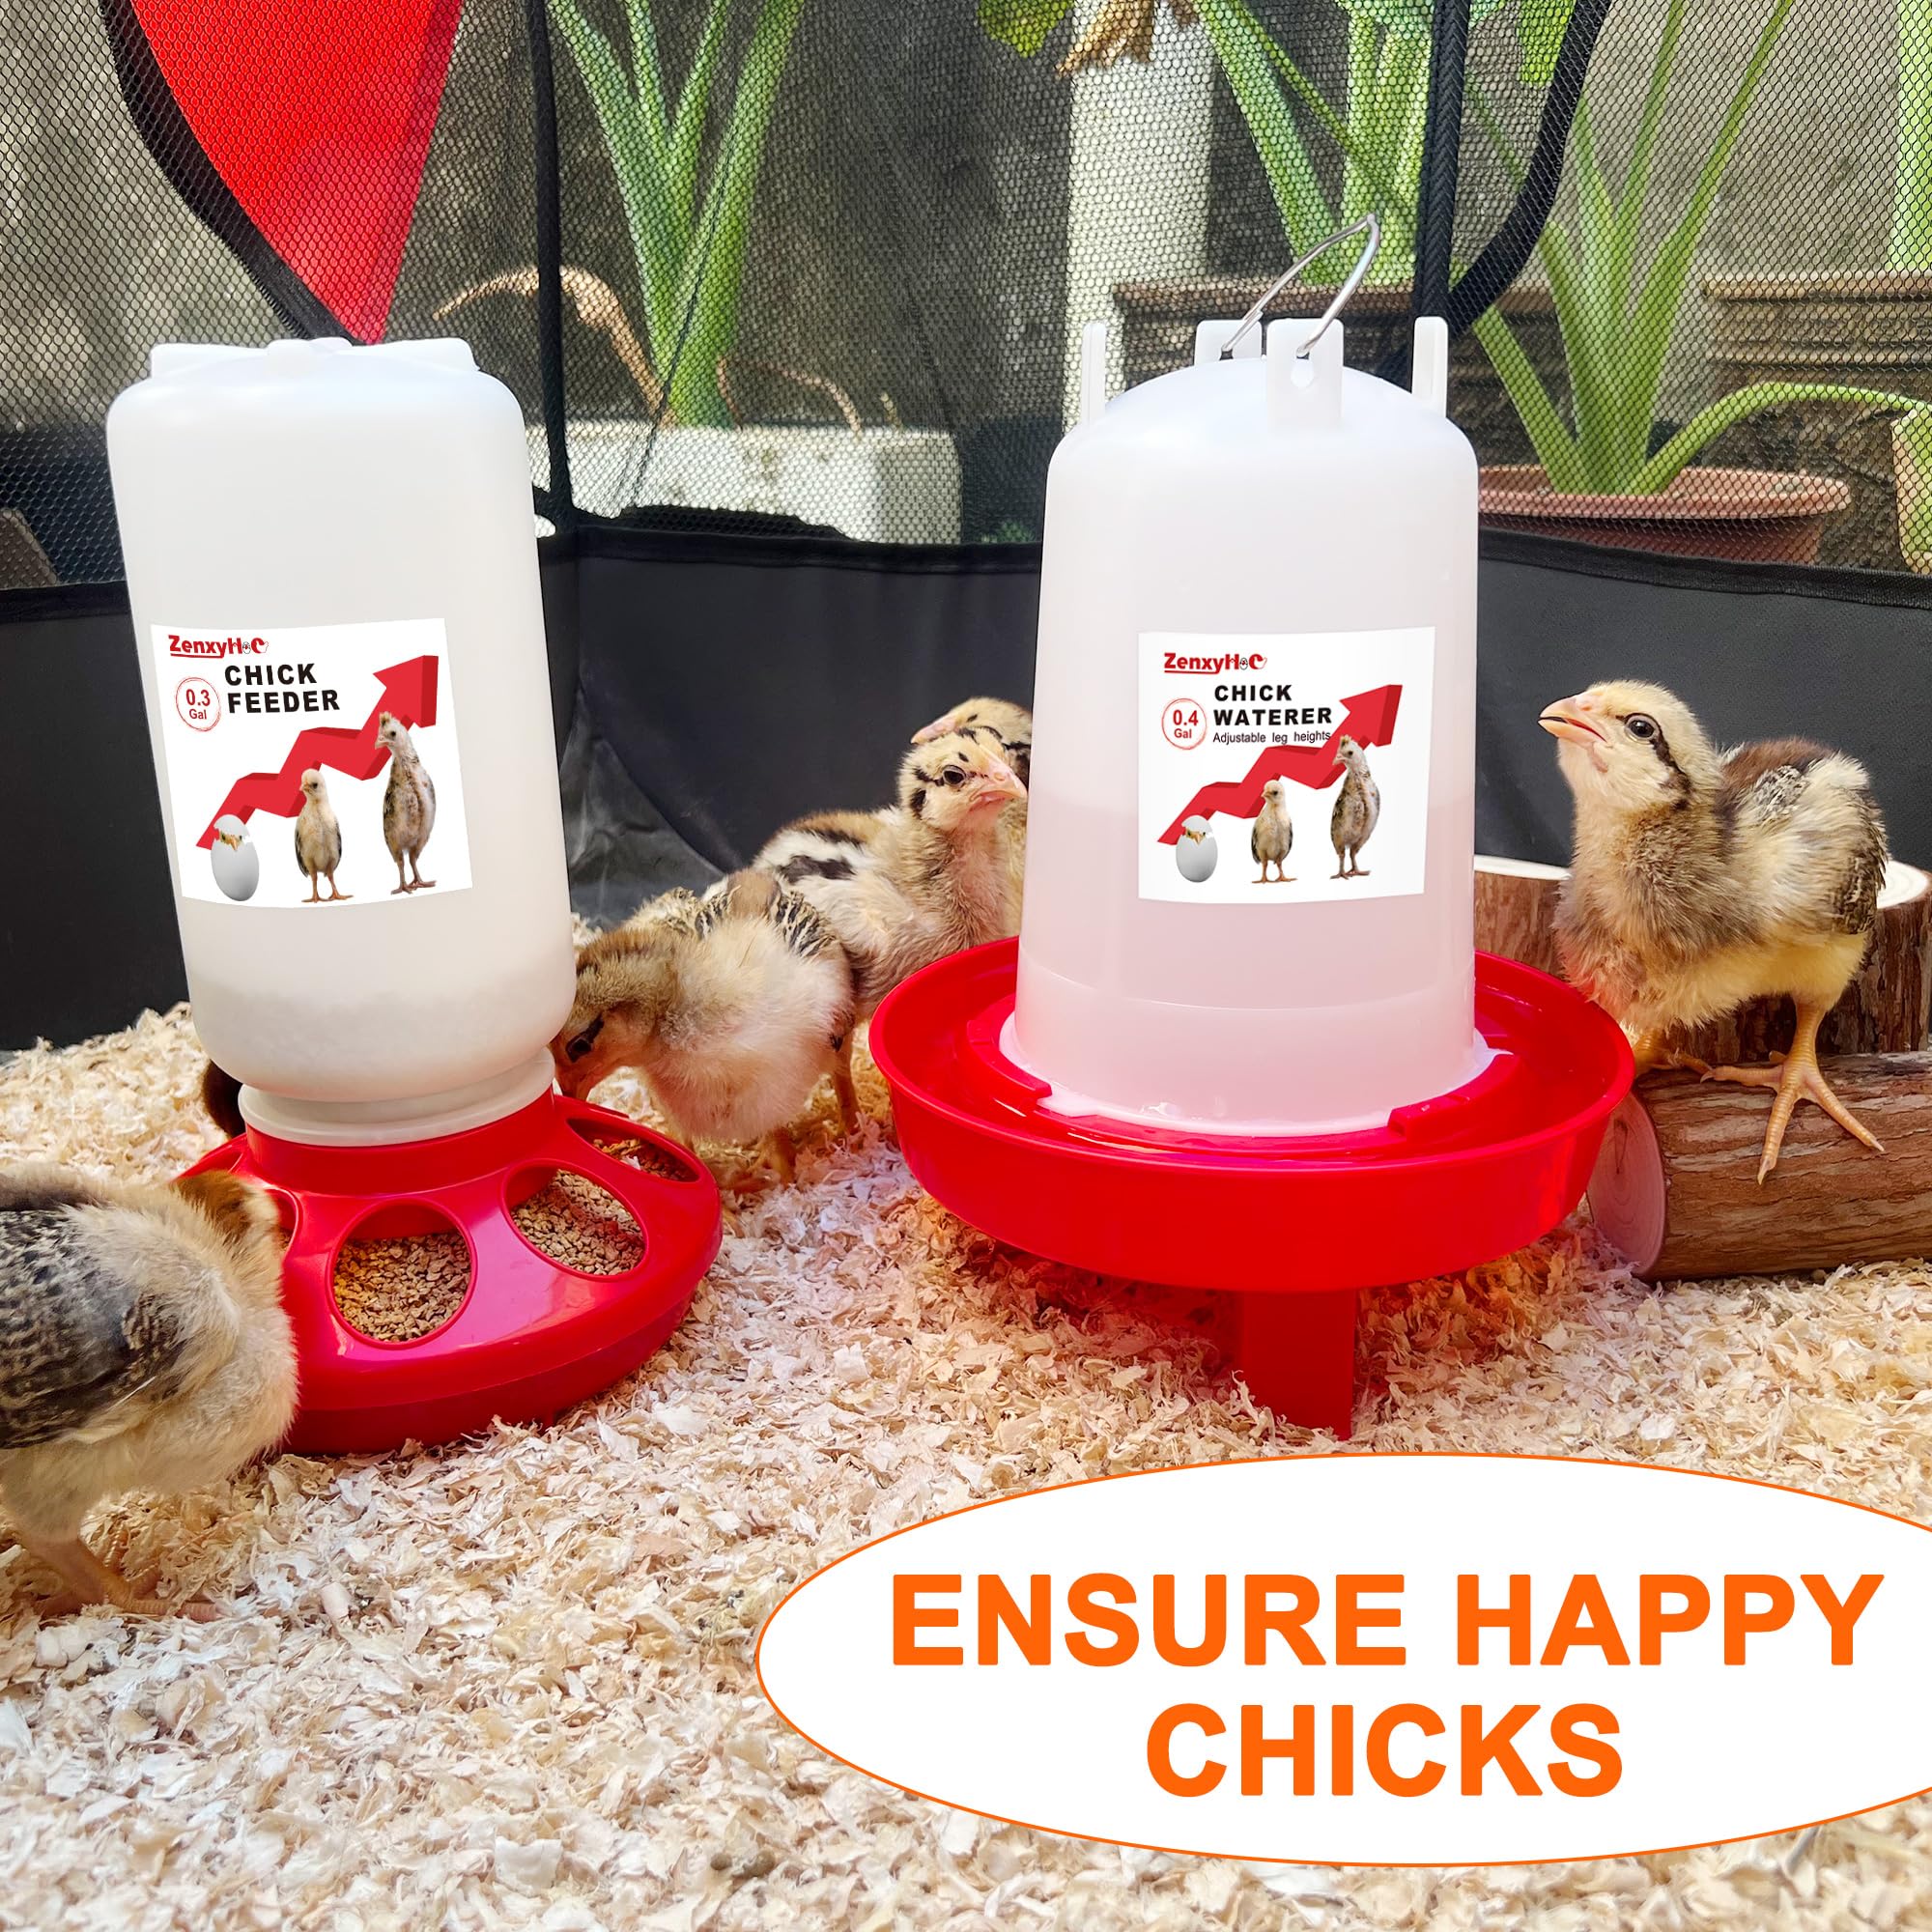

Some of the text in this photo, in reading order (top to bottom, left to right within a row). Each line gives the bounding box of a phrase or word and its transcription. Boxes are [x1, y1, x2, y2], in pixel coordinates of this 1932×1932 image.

[224, 663, 317, 686] CHICK
[185, 688, 211, 707] 0.3
[1214, 684, 1293, 701] CHICK
[227, 690, 340, 713] FEEDER
[188, 709, 207, 720] Gal
[1173, 709, 1199, 725] 0.4
[1213, 707, 1332, 725] WATERER
[1174, 728, 1192, 739] Gal
[1212, 730, 1331, 746] Adjustable leg heights
